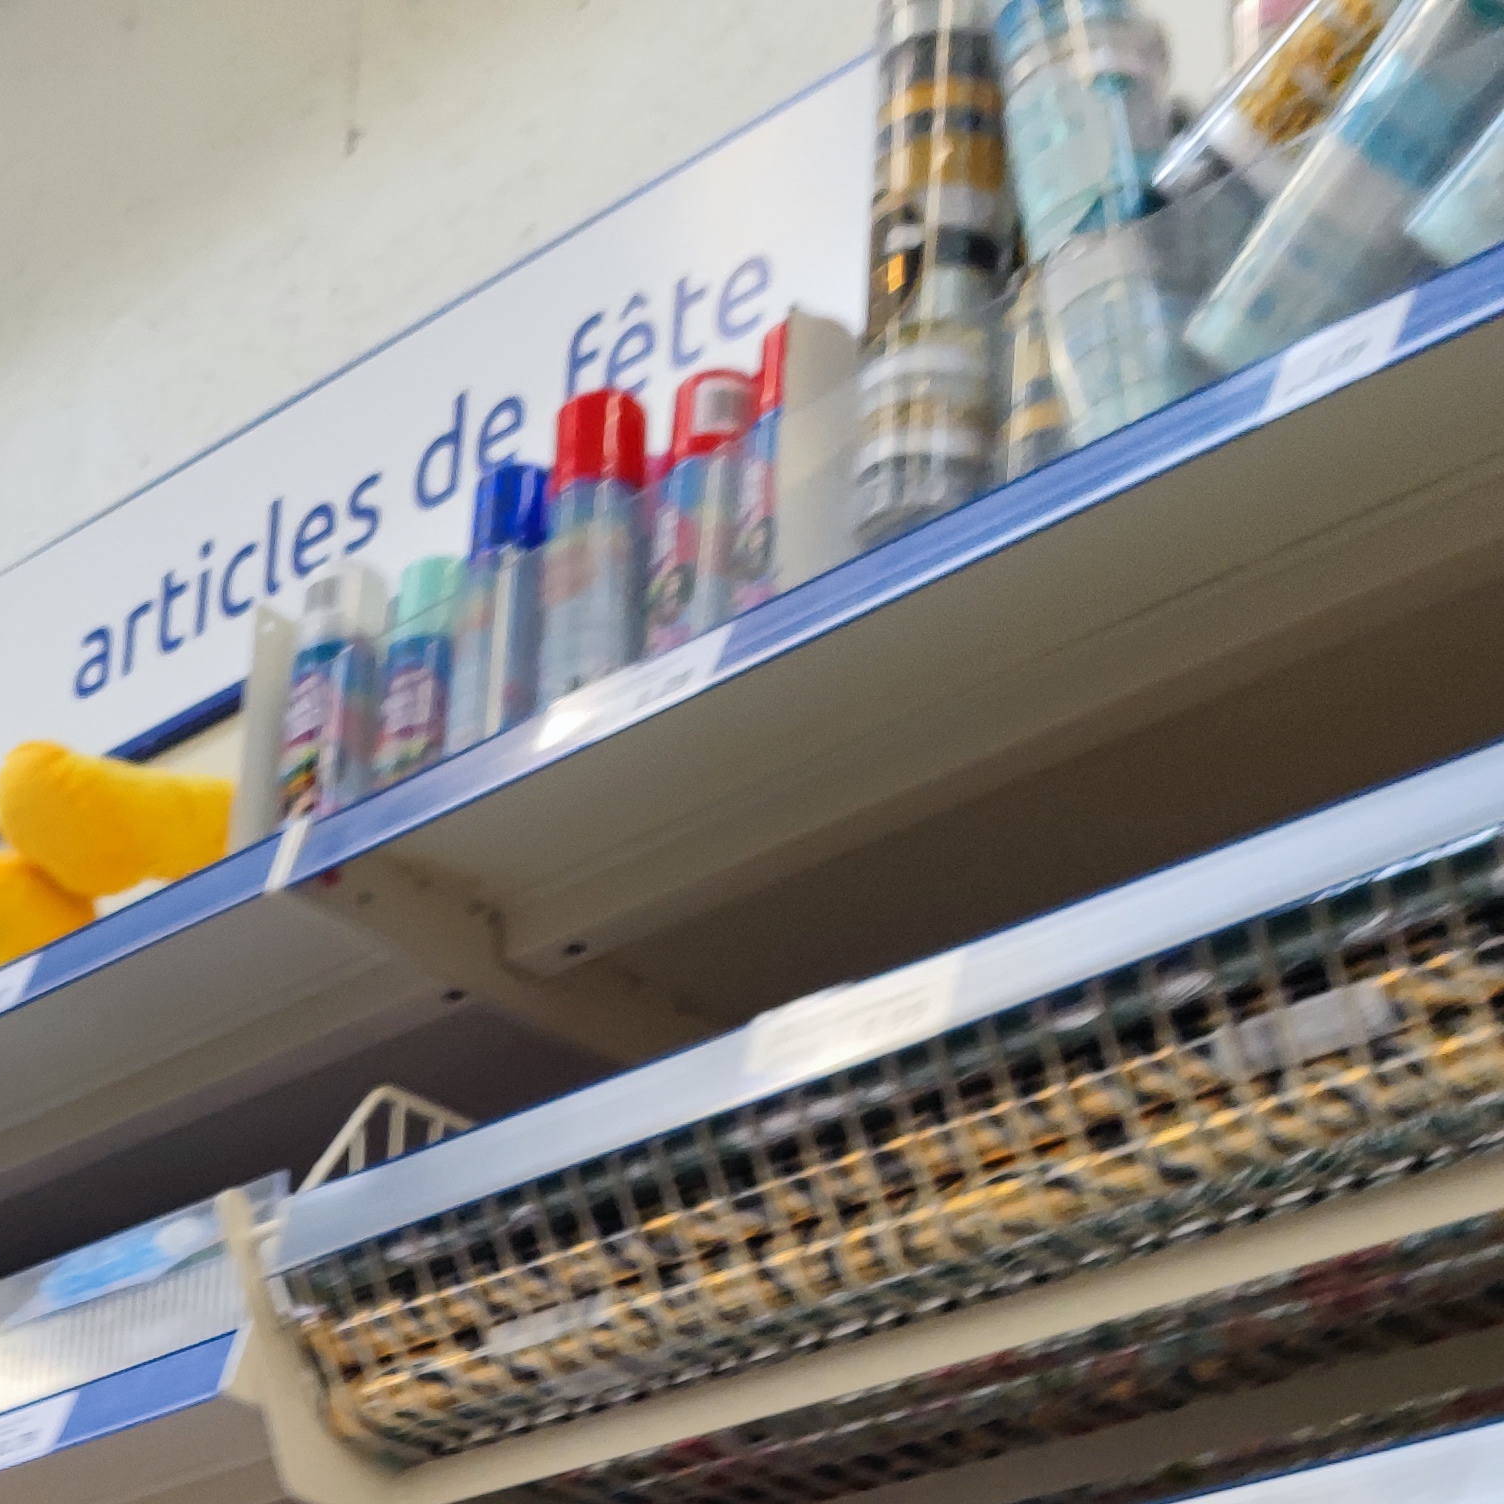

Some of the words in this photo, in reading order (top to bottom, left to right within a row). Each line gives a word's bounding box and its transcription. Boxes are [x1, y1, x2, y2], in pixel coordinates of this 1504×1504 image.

[72, 468, 383, 700] articles
[414, 387, 527, 512] de
[566, 252, 774, 396] fête
